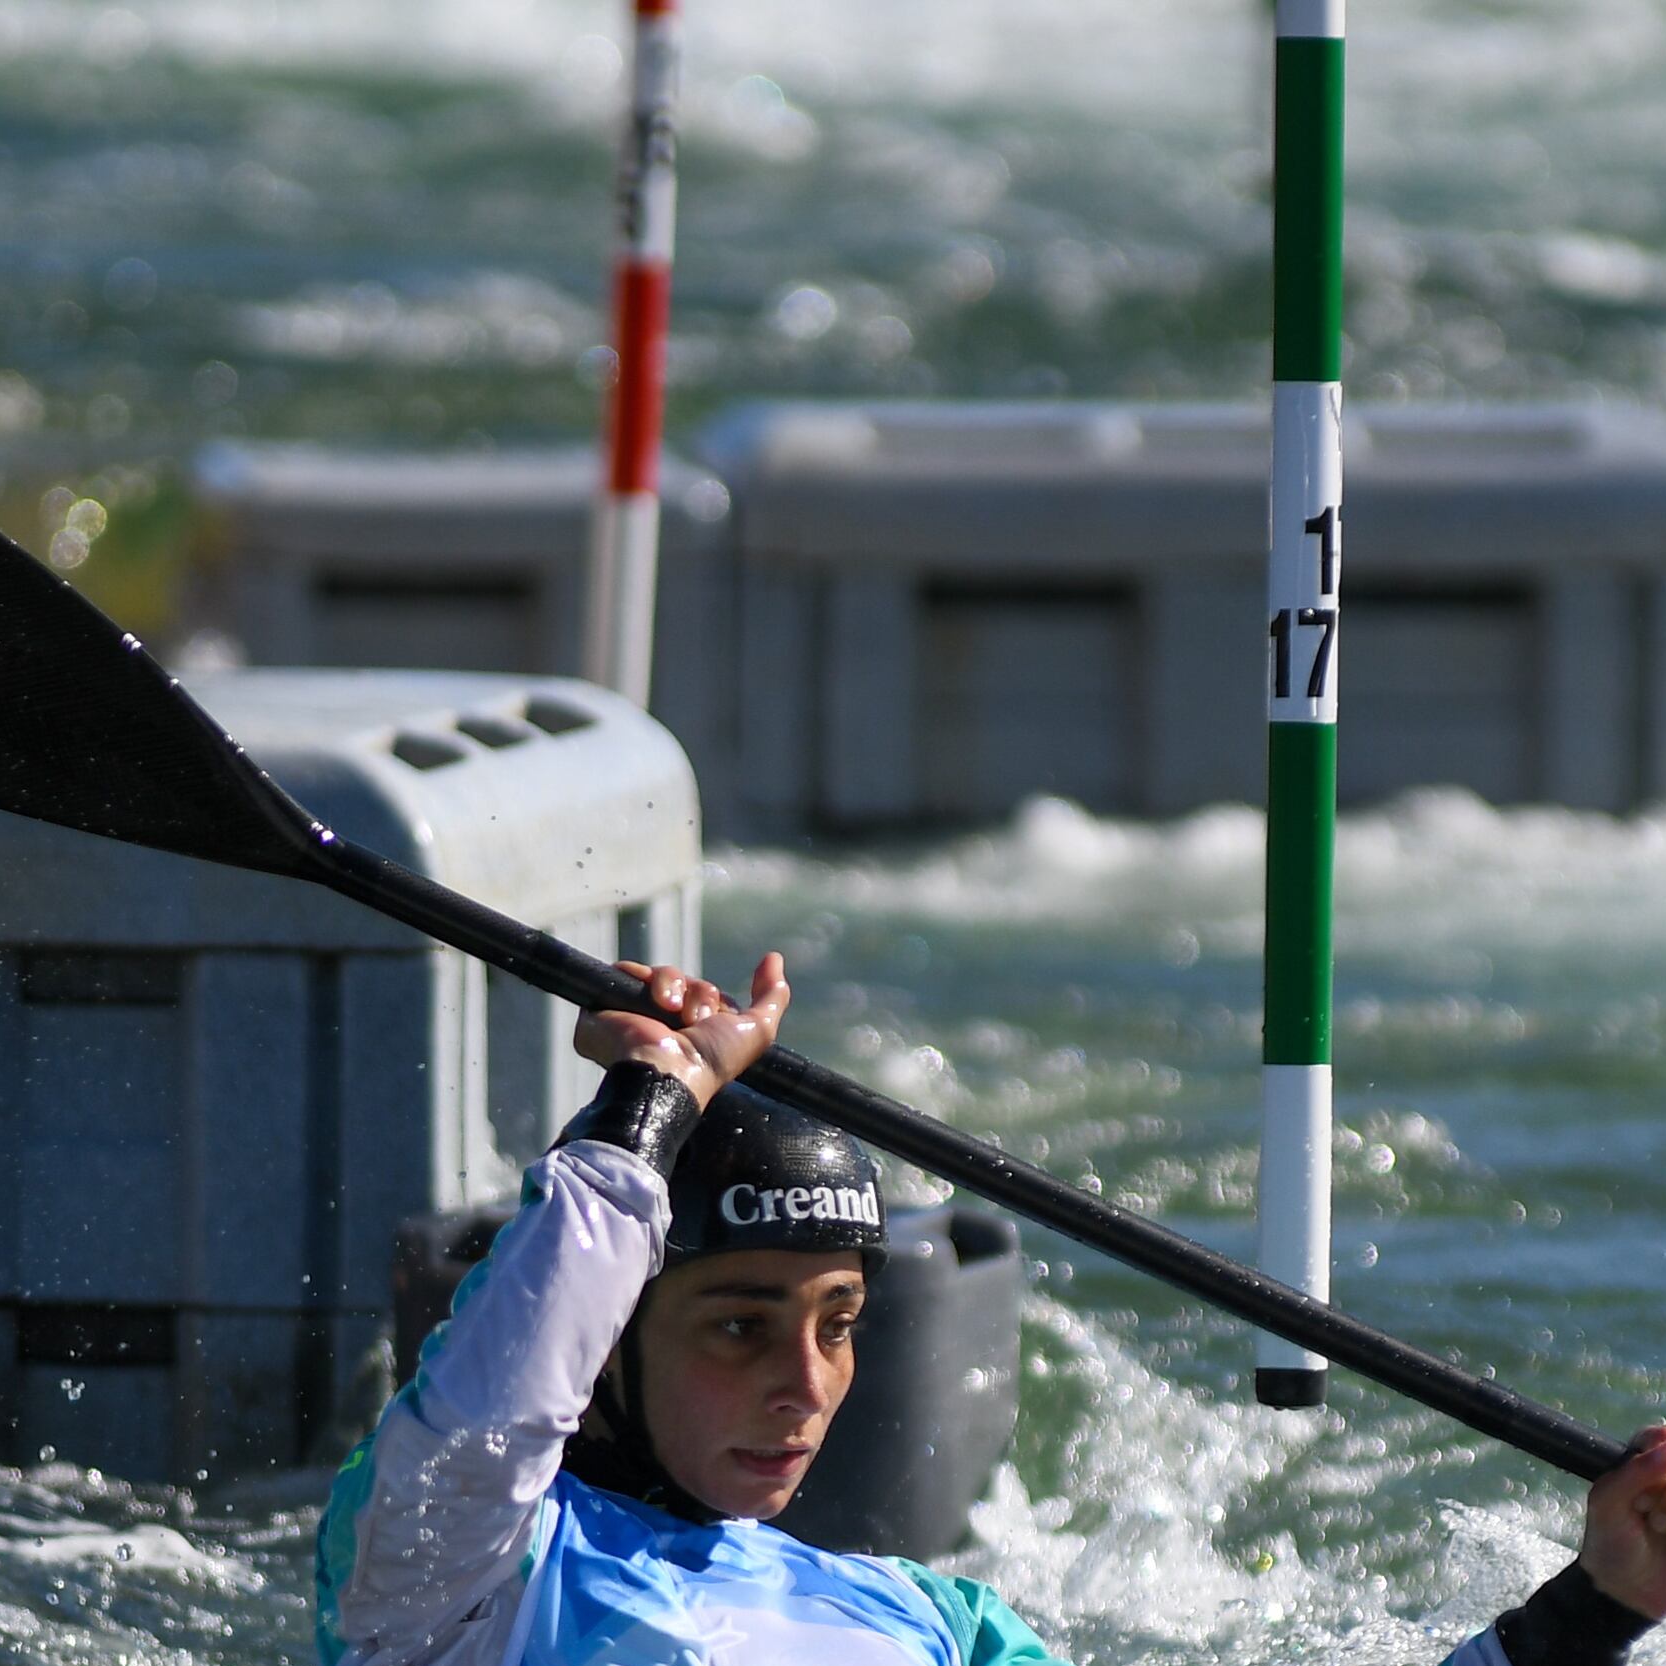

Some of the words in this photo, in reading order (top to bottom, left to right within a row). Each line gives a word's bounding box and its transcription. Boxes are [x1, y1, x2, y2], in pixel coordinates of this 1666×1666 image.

[1305, 506, 1339, 594] 1
[1270, 608, 1336, 698] 17
[721, 1181, 880, 1227] Creand
